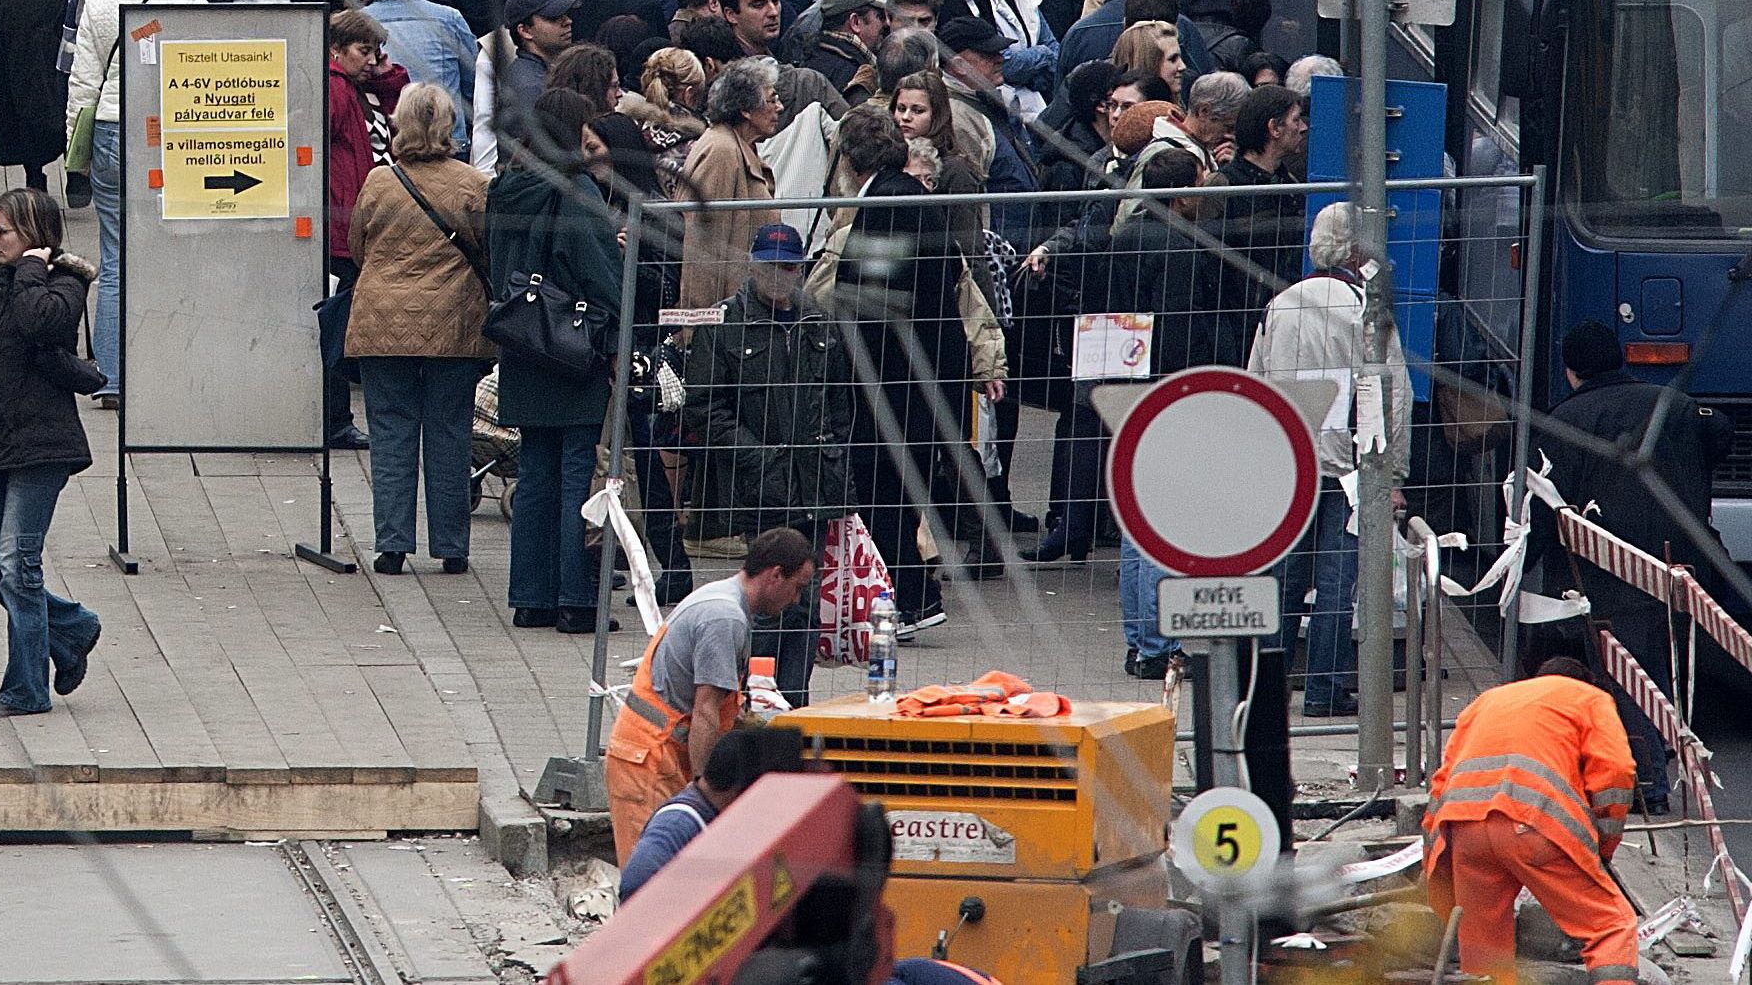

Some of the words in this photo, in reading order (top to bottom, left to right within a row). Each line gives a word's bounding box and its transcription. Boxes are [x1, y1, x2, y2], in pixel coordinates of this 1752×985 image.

[178, 52, 217, 63] Tisztelt
[221, 51, 273, 62] Utasaink!
[168, 79, 179, 88] A
[181, 78, 211, 88] 4-6V
[215, 76, 280, 91] pótlóbusz
[193, 95, 201, 103] a
[205, 92, 256, 106] Nyugati
[174, 109, 248, 123] pályaudvar
[251, 108, 274, 121] felé
[166, 142, 174, 150] a
[178, 138, 285, 152] villamosmegálló
[229, 153, 266, 164] indul.
[1193, 582, 1244, 604] KIVÉVE
[1216, 823, 1239, 866] 5
